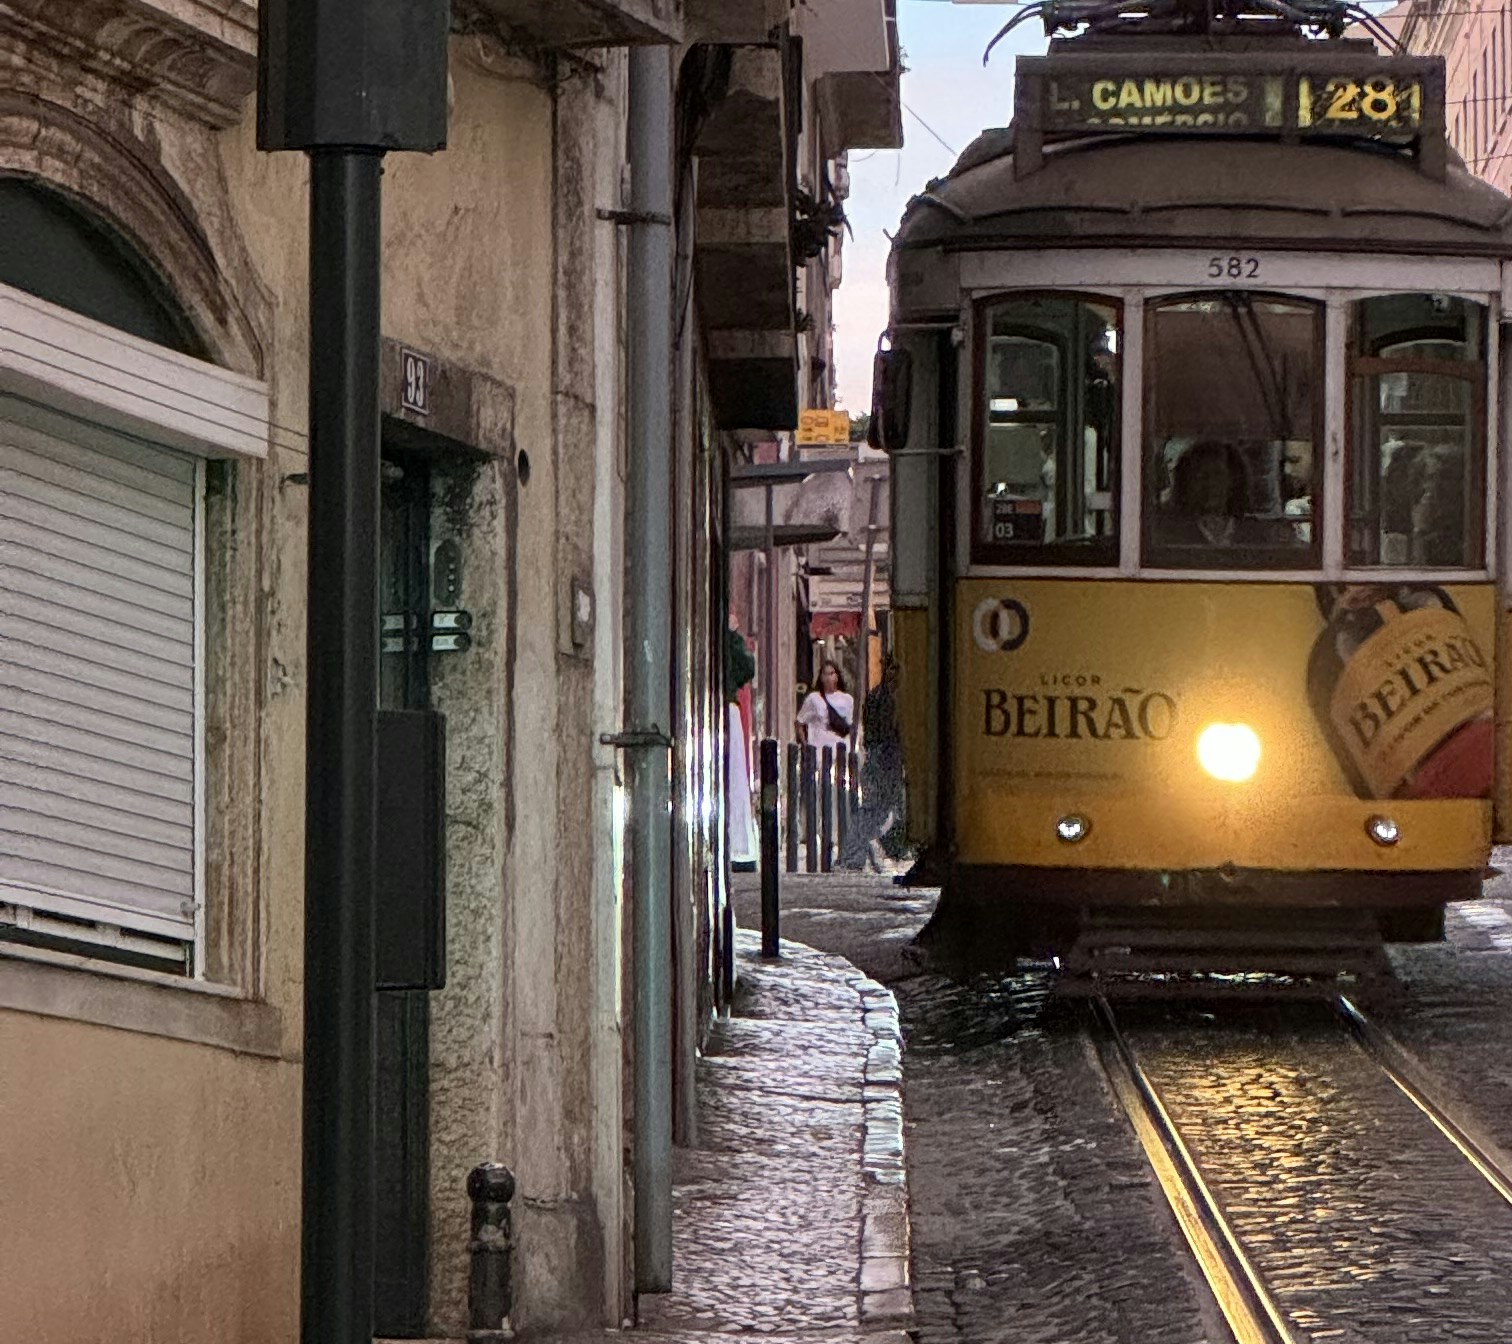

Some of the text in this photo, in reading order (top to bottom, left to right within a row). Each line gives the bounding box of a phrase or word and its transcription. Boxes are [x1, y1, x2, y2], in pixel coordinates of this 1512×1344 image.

[1207, 256, 1260, 279] 582
[406, 356, 425, 407] 93
[995, 522, 1014, 538] 03
[1040, 672, 1101, 687] LICOR
[980, 687, 1179, 741] BEIRÃO
